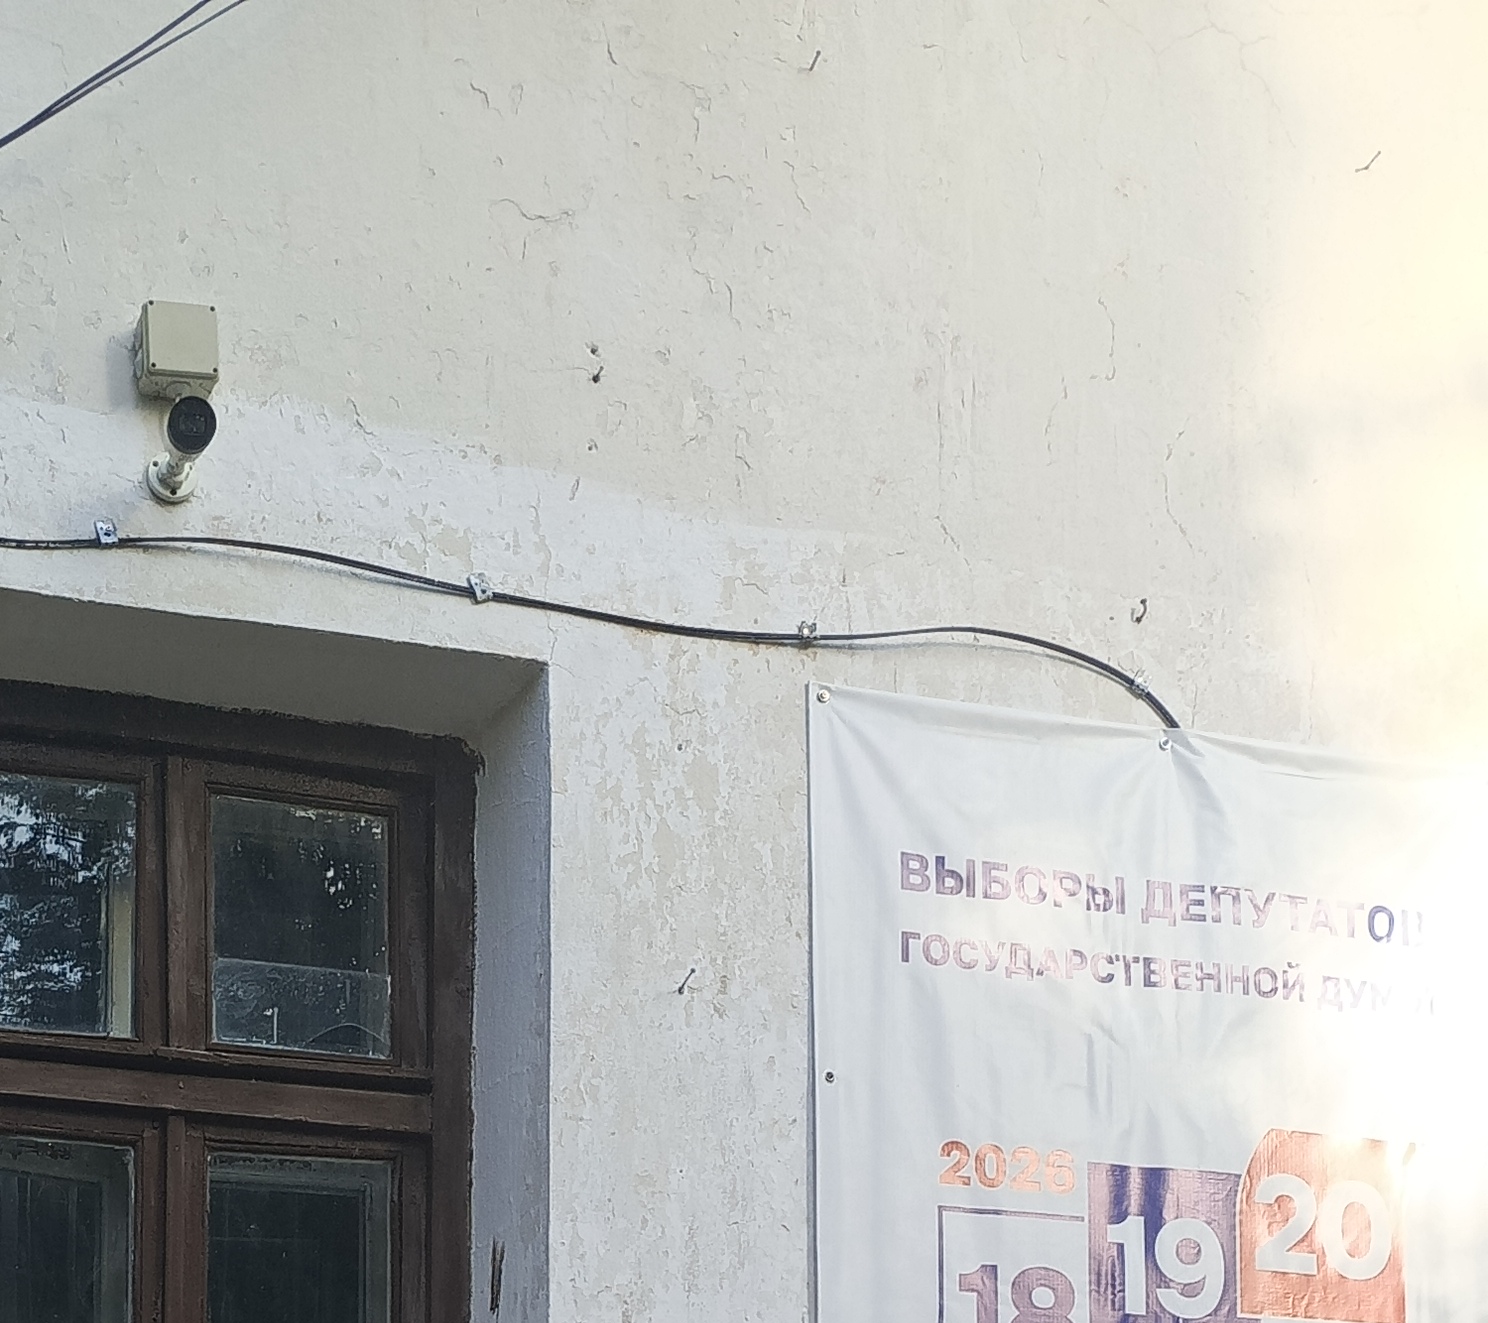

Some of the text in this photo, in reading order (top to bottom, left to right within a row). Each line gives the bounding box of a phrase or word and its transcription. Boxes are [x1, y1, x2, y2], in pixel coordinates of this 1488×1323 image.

[899, 851, 1125, 915] ВЫБОРЫ
[899, 930, 1305, 1002] ГОСУДАРСТВЕННОЙ
[938, 1140, 1075, 1193] 2026
[1108, 1215, 1224, 1319] 19
[1254, 1174, 1392, 1280] 20
